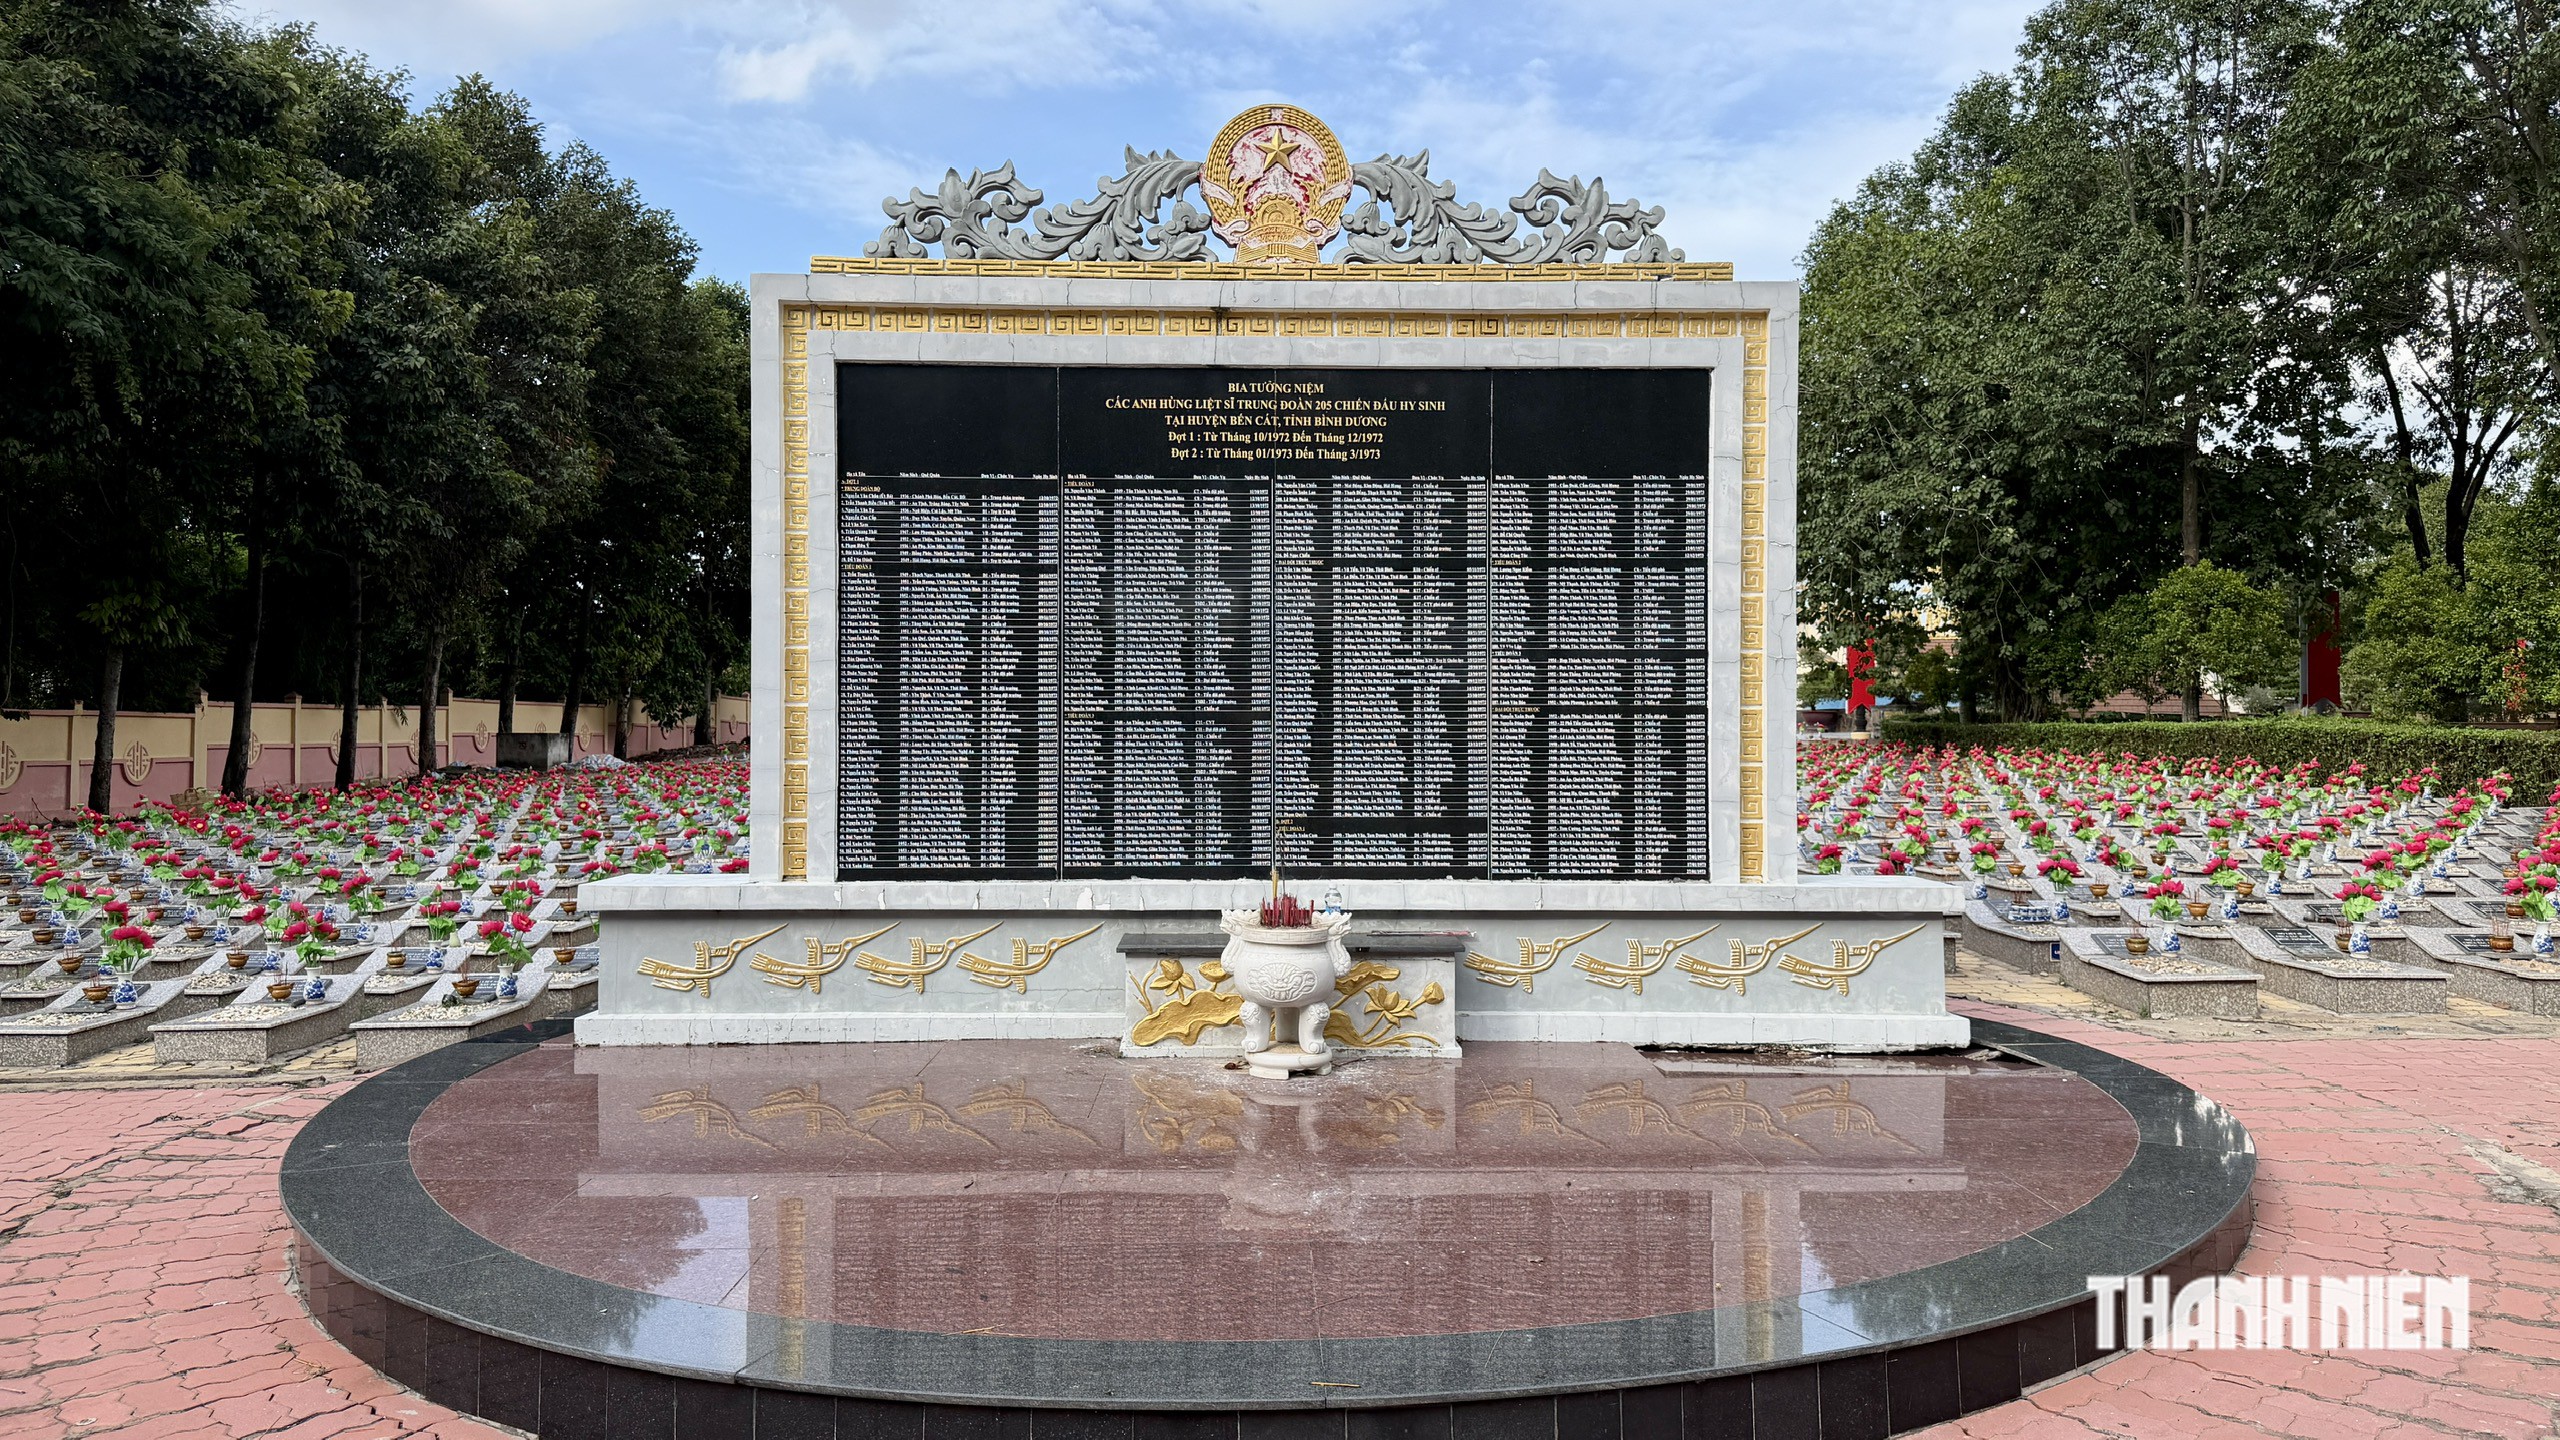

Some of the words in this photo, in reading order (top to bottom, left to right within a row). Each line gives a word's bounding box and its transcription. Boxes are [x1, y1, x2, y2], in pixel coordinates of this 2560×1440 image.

[1228, 383, 1248, 392] BIA
[1249, 380, 1291, 393] TƯỜNG
[1294, 382, 1324, 395] NIỆM
[1106, 395, 1130, 409] CÁC
[1132, 399, 1156, 409] ANH
[1160, 396, 1193, 409] HÙNG
[1196, 397, 1222, 411] LIỆT
[1224, 397, 1234, 409] SĨ
[1237, 399, 1277, 410] TRUNG
[1281, 397, 1313, 410] ĐOÀN
[1315, 400, 1332, 410] 205
[1335, 397, 1371, 410] CHIẾN
[1374, 397, 1397, 410] ĐẤU
[1400, 401, 1416, 410] HY
[1419, 401, 1446, 410] SINH
[1165, 415, 1184, 427] TẠI
[1188, 414, 1227, 427] HUYỆN
[1230, 413, 1253, 425] BẾN
[1255, 413, 1281, 427] CÁT,
[1283, 413, 1312, 426] TỈNH
[1315, 414, 1342, 426] BÌNH
[1345, 416, 1387, 426] DƯƠNG
[1169, 432, 1186, 443] Đợt
[1190, 432, 1194, 441] 1
[1203, 431, 1218, 441] Từ
[1220, 431, 1251, 443] Tháng
[1254, 432, 1290, 442] 10/1972
[1293, 430, 1312, 442] Đến
[1314, 432, 1345, 444] Tháng
[1348, 433, 1384, 442] 12/1972
[1172, 448, 1189, 460] Đợt
[1192, 448, 1197, 458] 2
[1206, 448, 1221, 458] Từ
[1223, 447, 1253, 461] Tháng
[1256, 448, 1293, 459] 01/1973
[1296, 446, 1315, 459] Đến
[1317, 448, 1347, 461] Tháng
[1350, 449, 1381, 459] 3/1973
